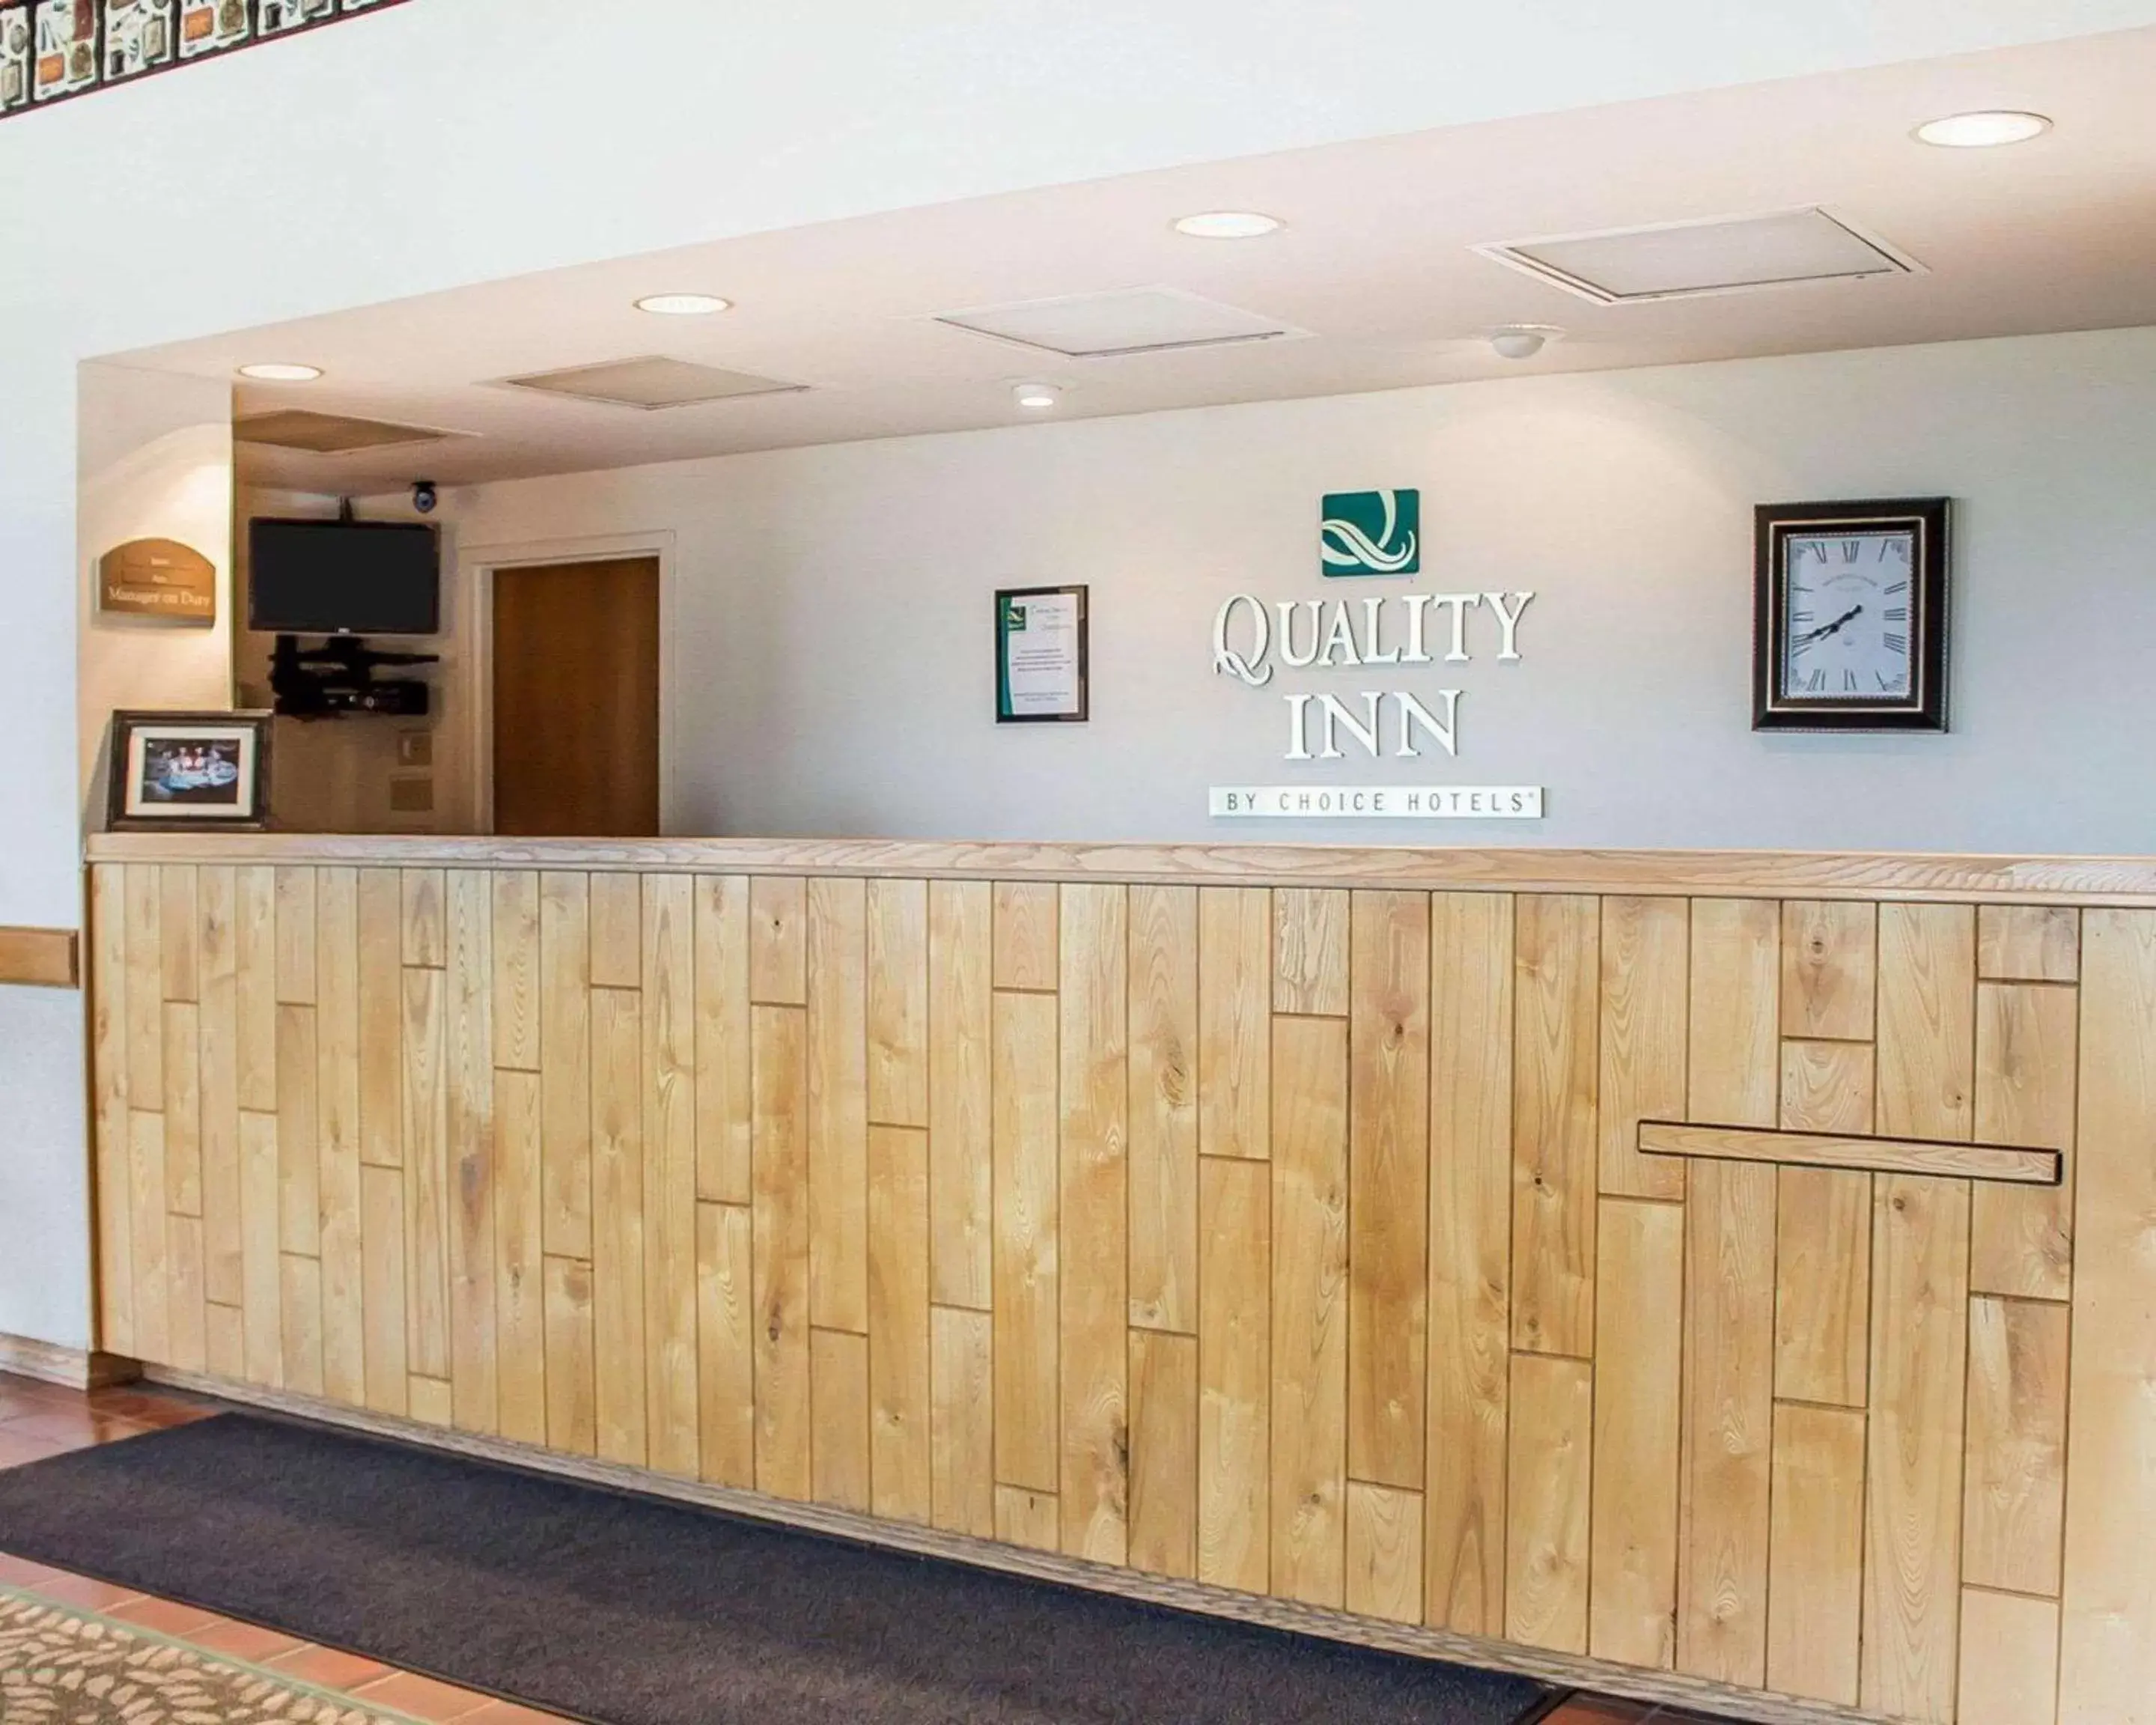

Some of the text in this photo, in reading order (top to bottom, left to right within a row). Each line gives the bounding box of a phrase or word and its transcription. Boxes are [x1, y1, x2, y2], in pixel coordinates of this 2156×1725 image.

[1212, 591, 1536, 687] QUALITY
[1282, 689, 1463, 760] INN
[1227, 791, 1256, 812] BY
[1279, 791, 1385, 812] CHOICE
